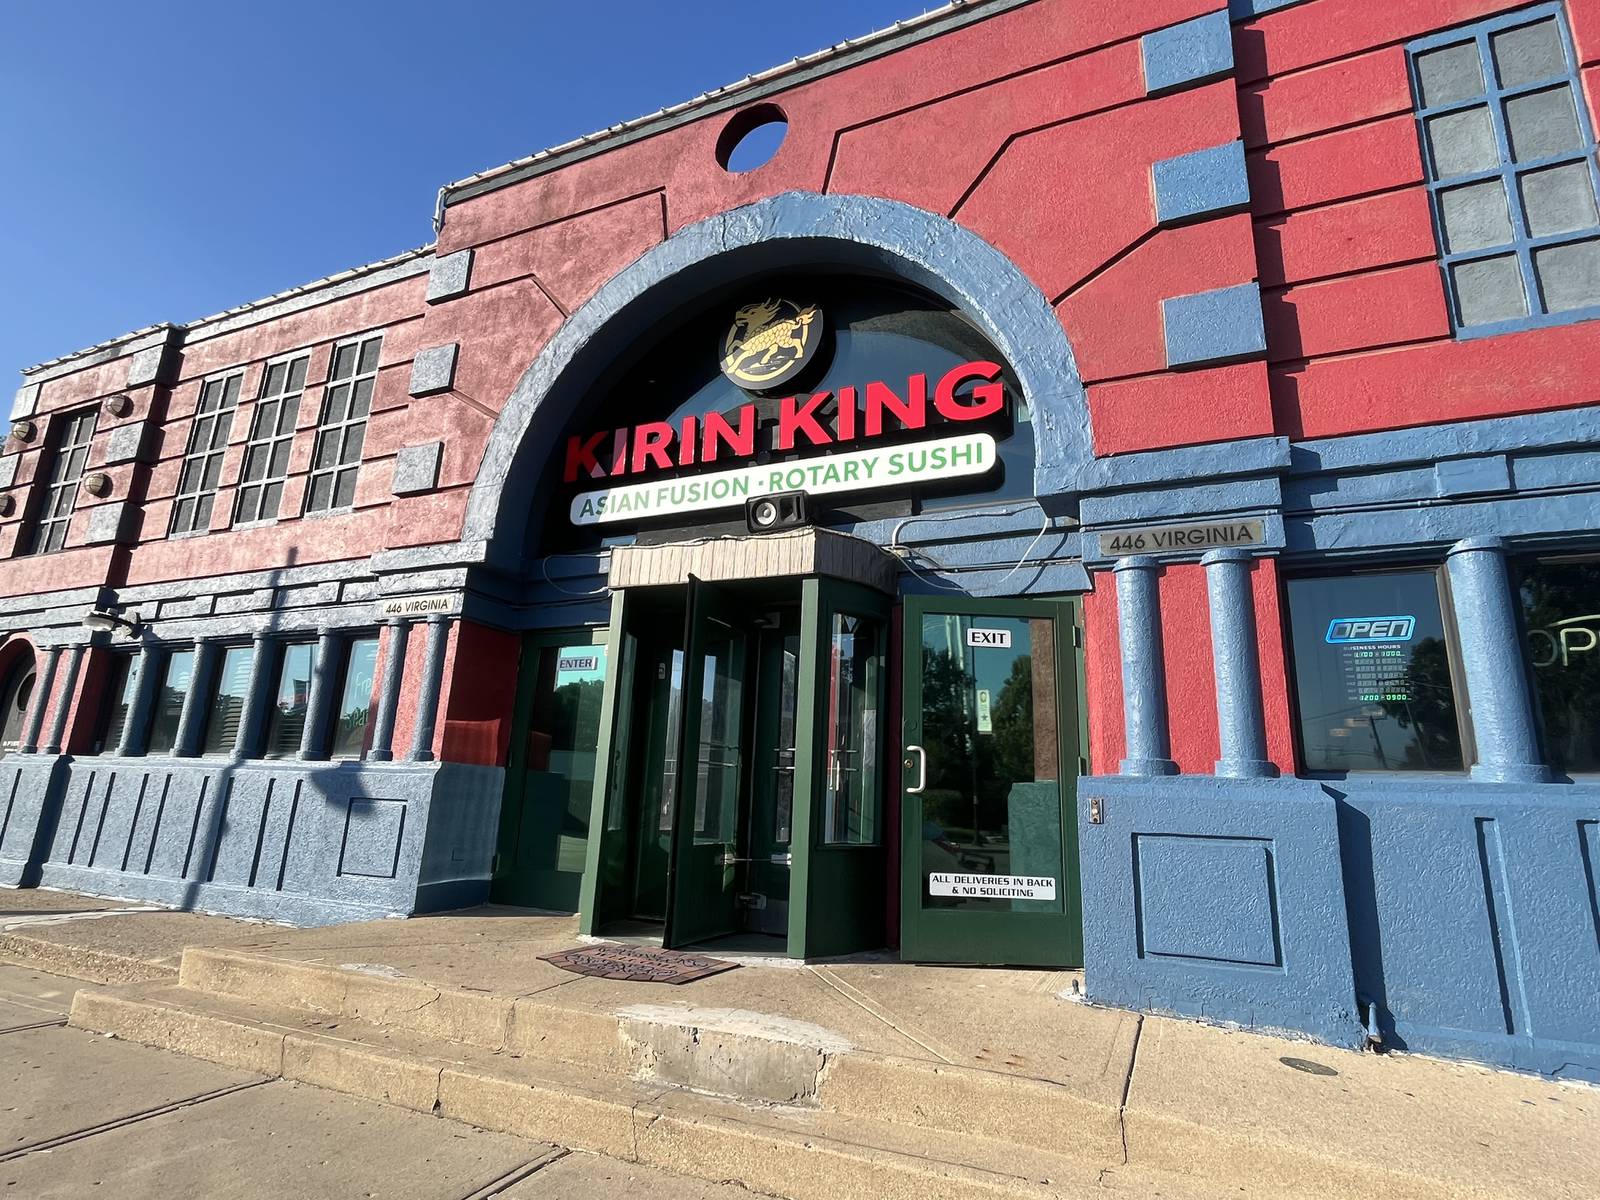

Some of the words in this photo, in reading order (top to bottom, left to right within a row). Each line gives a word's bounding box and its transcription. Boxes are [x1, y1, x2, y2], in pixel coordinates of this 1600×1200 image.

[563, 403, 757, 482] KIRIN
[778, 360, 1004, 450] KING
[579, 489, 650, 518] ASIAN
[656, 475, 750, 508] FUSION
[768, 456, 880, 493] ROTARY
[887, 442, 983, 476] SUSHI
[1109, 533, 1146, 551] 446
[1151, 524, 1254, 548] VIRGINIA
[385, 602, 402, 614] 446
[405, 598, 449, 612] VIRGINIA
[971, 631, 1008, 645] EXIT
[1331, 620, 1410, 639] OPEN
[1527, 626, 1600, 668] OP
[560, 658, 593, 669] ENTER
[932, 875, 951, 884] ALL
[954, 875, 1010, 886] DELIVERIES
[1013, 878, 1024, 886] IN
[1027, 879, 1053, 888] BACK
[951, 886, 959, 895] &
[962, 886, 977, 895] NO
[980, 887, 1034, 898] SOLICITING
